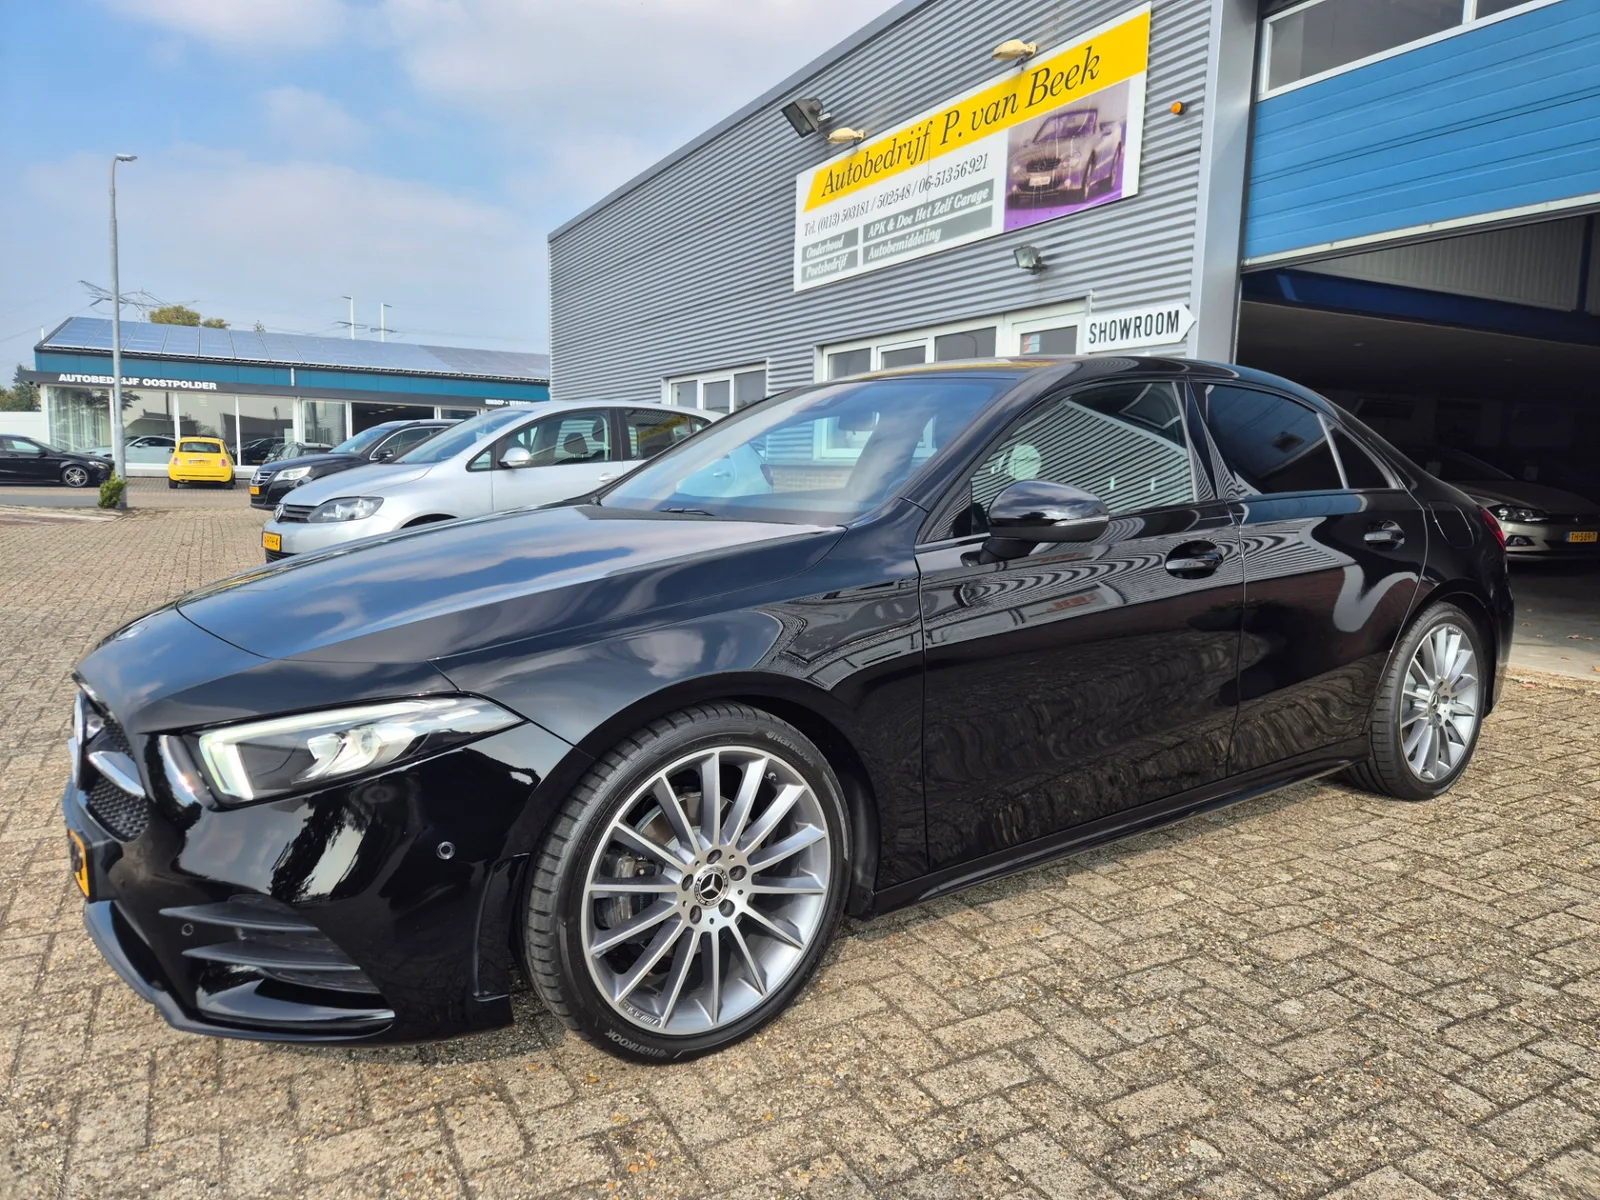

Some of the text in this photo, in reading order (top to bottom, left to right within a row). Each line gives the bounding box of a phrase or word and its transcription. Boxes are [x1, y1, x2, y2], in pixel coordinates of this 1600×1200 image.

[820, 45, 1101, 198] Autobedrijf P. van Beek
[804, 222, 816, 236] Tel.
[817, 213, 840, 234] (0113)
[841, 200, 869, 223] 503181
[877, 184, 911, 209] 502548
[867, 187, 989, 238] APK & Doe Het Zelf Garage
[806, 234, 845, 259] Onderhoud
[867, 228, 942, 260] Autobemiddeling
[1088, 309, 1180, 344] SHOWROOM
[58, 373, 217, 390] AUTOBEDIJF OOSTPOLDER
